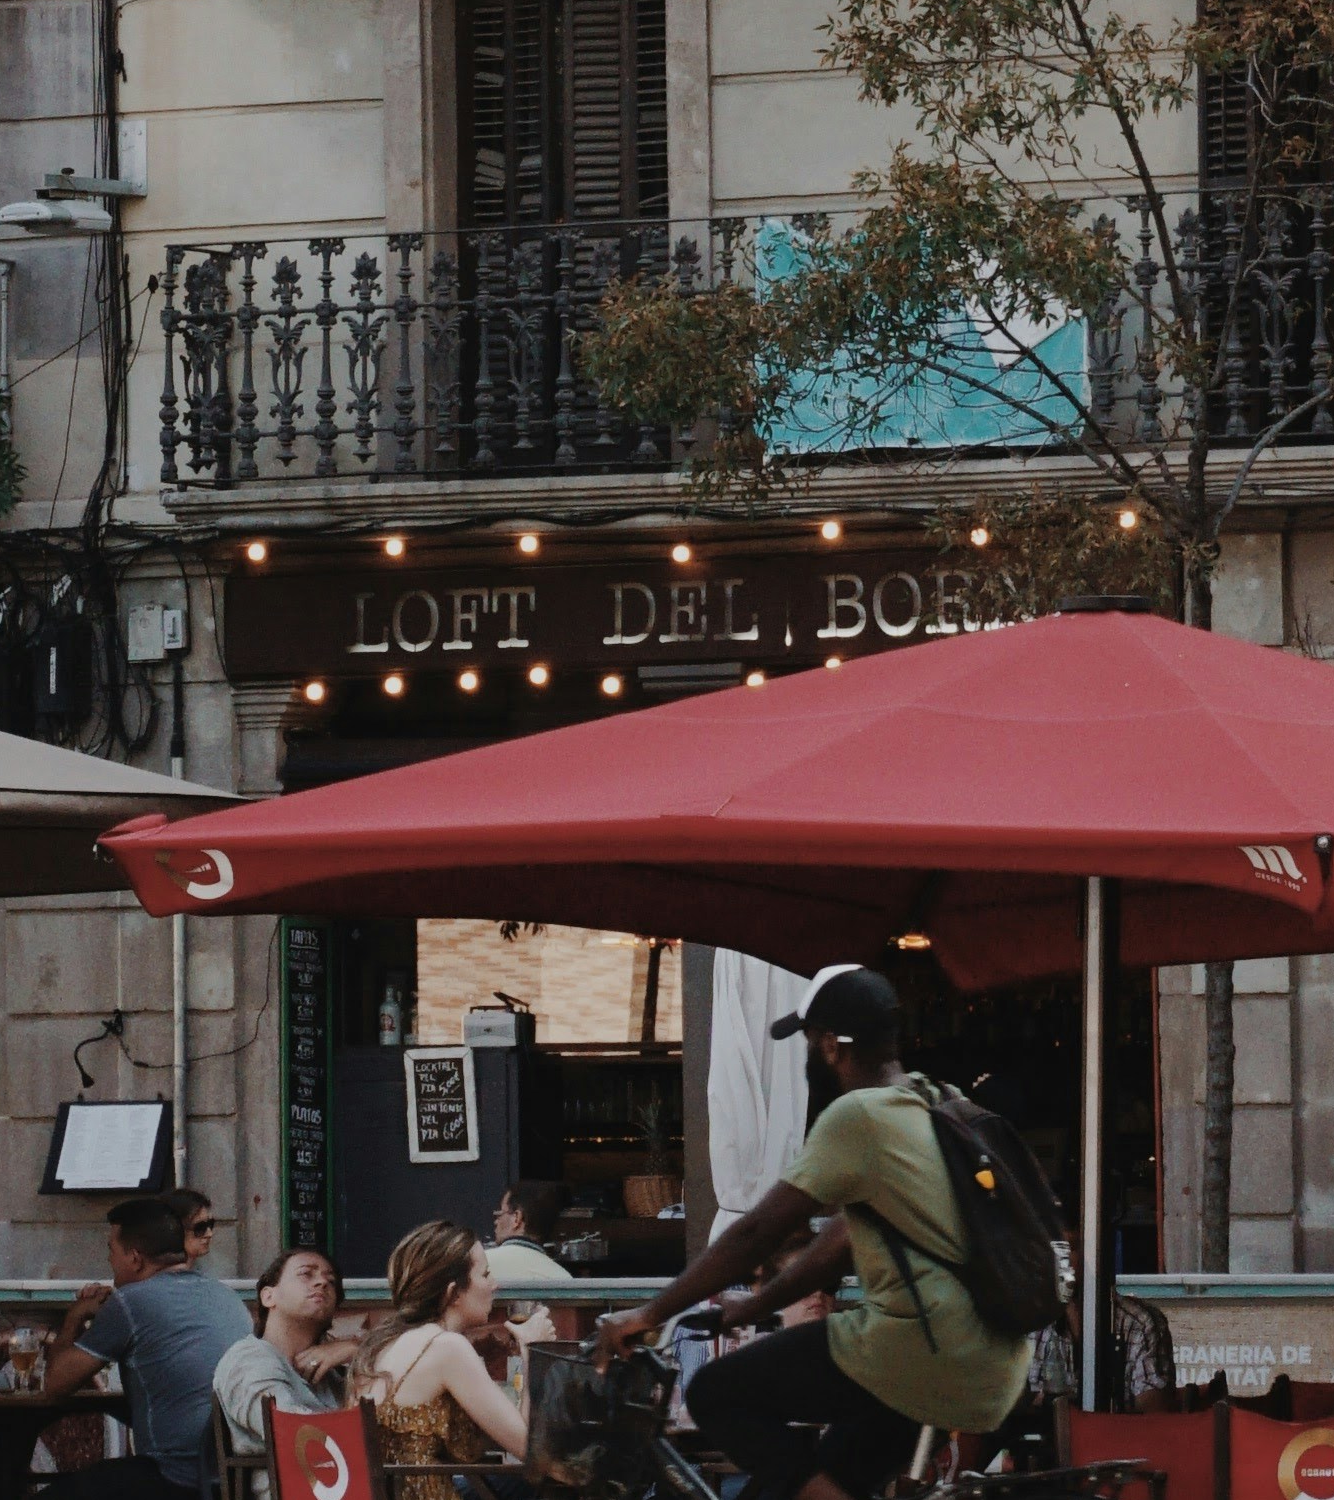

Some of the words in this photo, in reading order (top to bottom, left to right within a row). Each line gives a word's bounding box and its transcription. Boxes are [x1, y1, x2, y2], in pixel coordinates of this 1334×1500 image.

[345, 586, 536, 654] LOFT
[603, 578, 760, 646] DEL
[1282, 1345, 1312, 1364] DE
